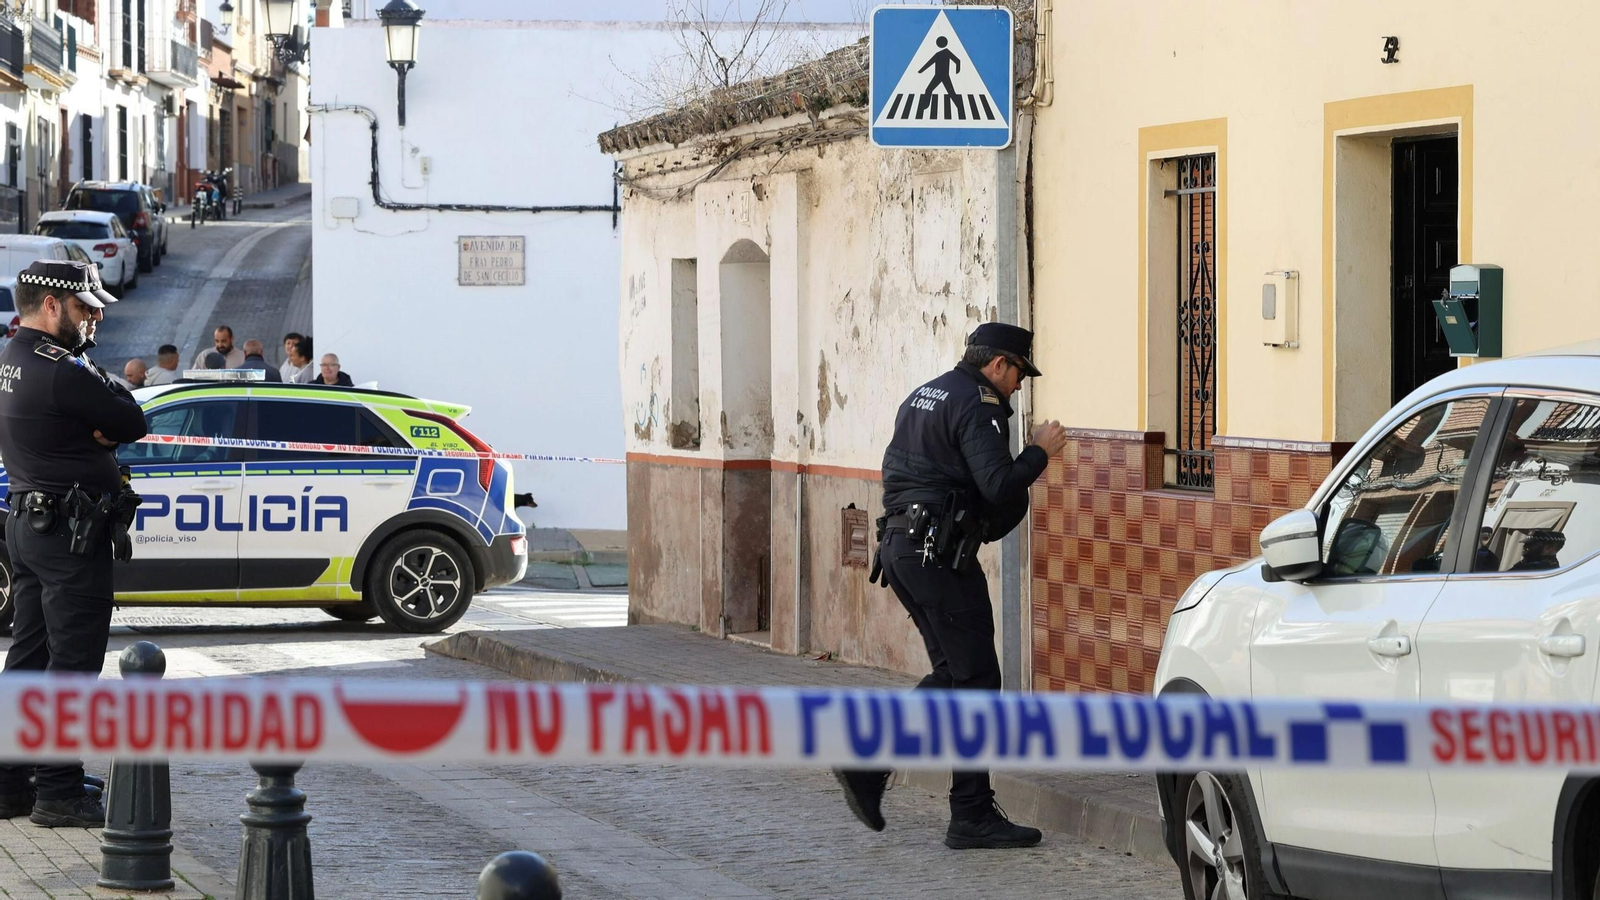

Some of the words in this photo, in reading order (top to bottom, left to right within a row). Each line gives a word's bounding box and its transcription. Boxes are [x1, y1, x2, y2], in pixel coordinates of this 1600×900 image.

[470, 241, 505, 251] AVENIDA
[510, 241, 520, 251] DE
[470, 257, 487, 267] FRAY
[491, 257, 513, 267] PEDRO
[464, 271, 472, 281] DE
[476, 271, 489, 281] SAN
[493, 271, 519, 281] CECILIO
[0, 364, 22, 380] ICIA
[915, 386, 949, 401] POLICIA
[910, 396, 936, 411] LOCAL
[420, 428, 438, 437] 112
[135, 486, 348, 532] POLICÍA
[135, 535, 197, 544] @policia_viso
[17, 687, 325, 754] SEGURIDAD
[1076, 695, 1276, 760] LOCAL
[1430, 708, 1600, 764] SEGURI
